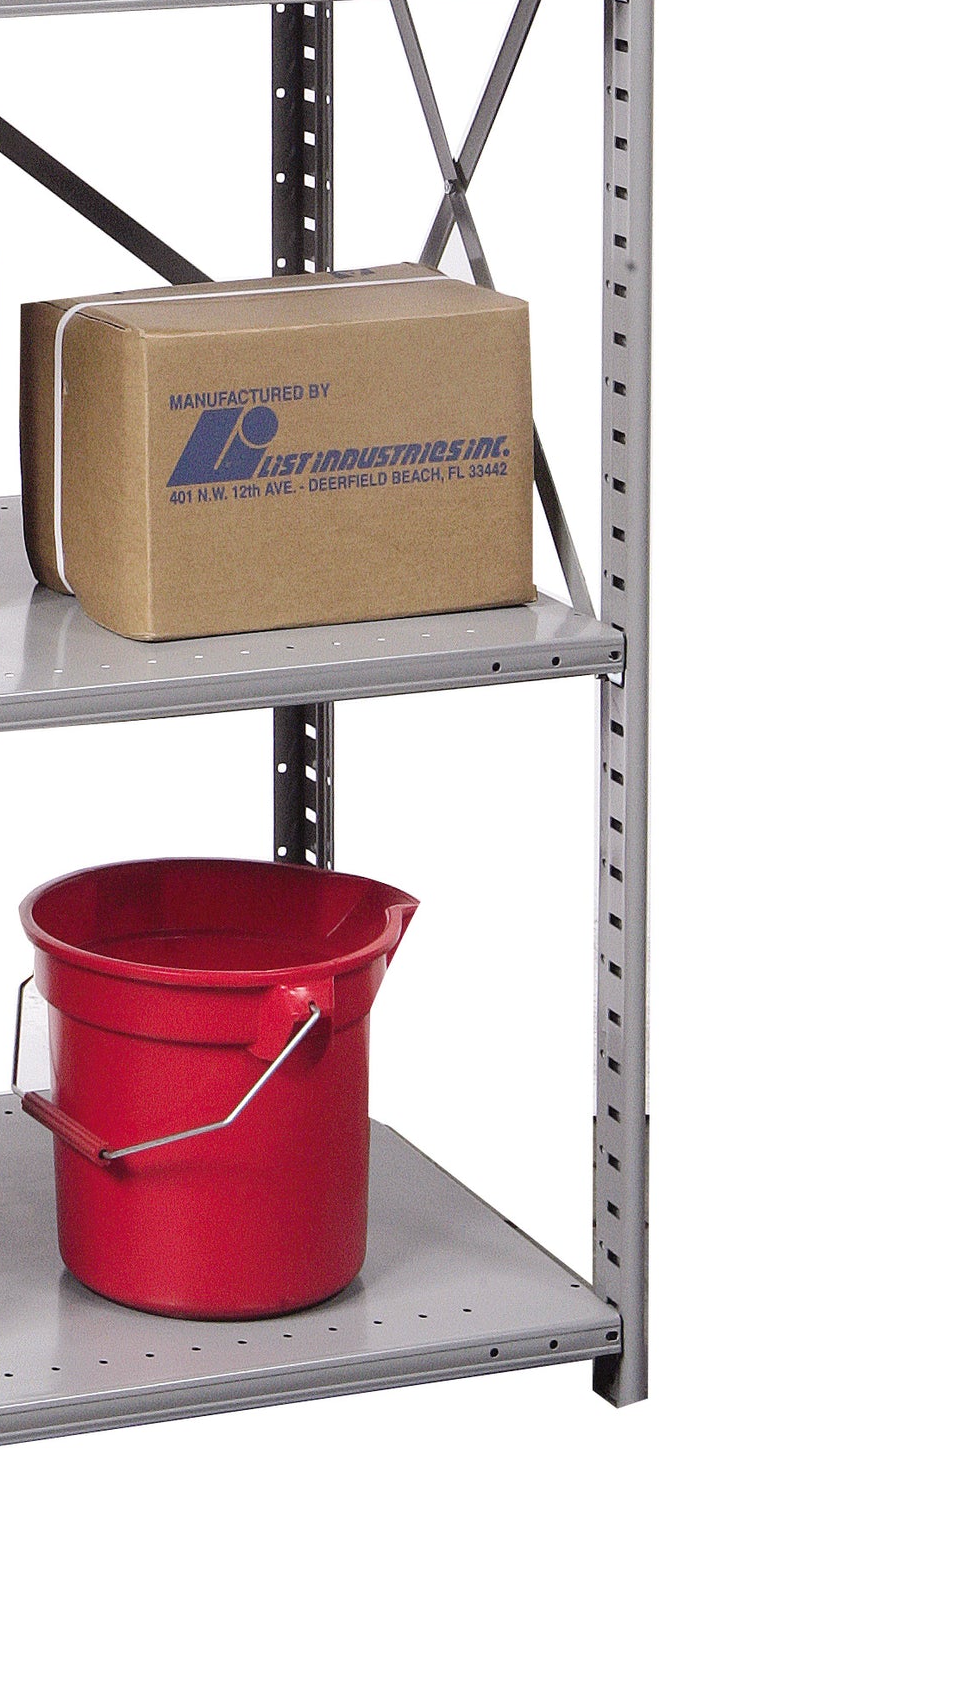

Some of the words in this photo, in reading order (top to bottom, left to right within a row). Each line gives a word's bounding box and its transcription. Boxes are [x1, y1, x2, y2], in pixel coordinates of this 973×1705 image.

[169, 385, 305, 411] MANUFACTURED
[308, 382, 331, 399] BY
[169, 488, 193, 505] 401
[198, 486, 228, 502] N.W.
[232, 483, 261, 499] 12th
[264, 479, 297, 497] AVE.
[308, 471, 388, 493] DEERFIELD
[392, 466, 445, 485] BEACH,
[448, 465, 465, 481] FL
[469, 461, 508, 478] 33442
